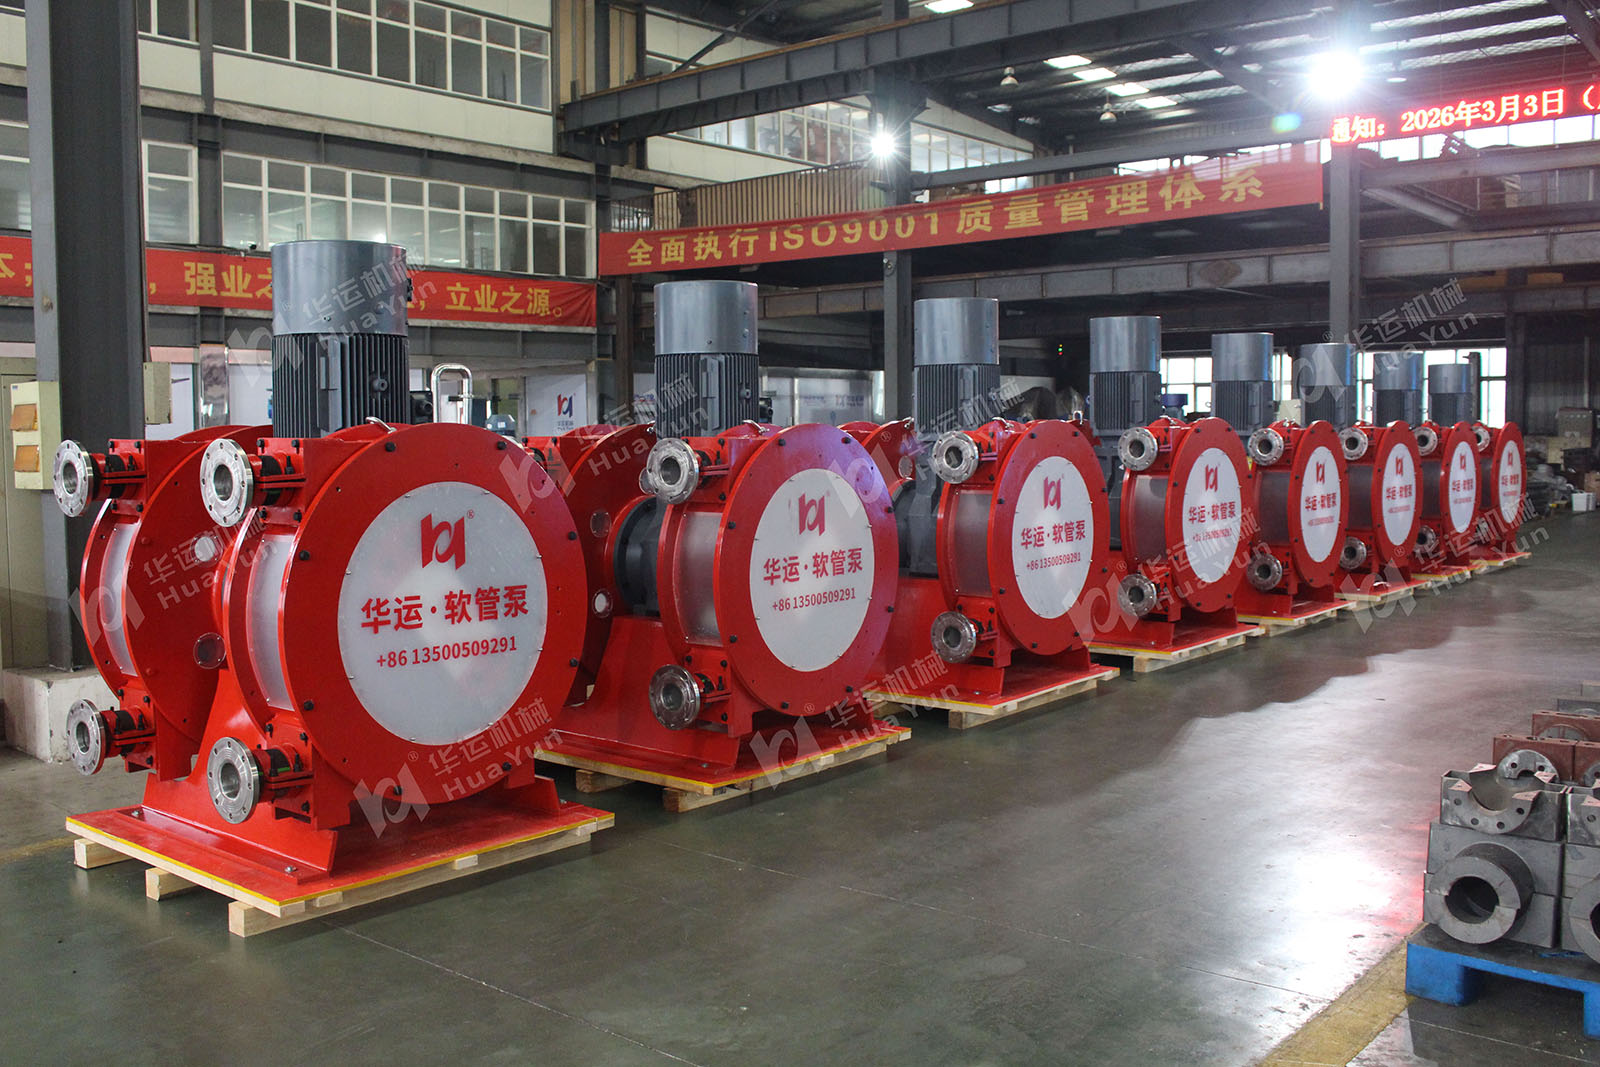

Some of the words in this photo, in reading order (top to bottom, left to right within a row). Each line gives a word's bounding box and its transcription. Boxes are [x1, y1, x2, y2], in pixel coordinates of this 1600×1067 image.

[361, 584, 529, 635] 华运·软管泵
[772, 598, 791, 612] +86
[793, 587, 856, 609] 13500509291
[377, 650, 407, 669] +86
[412, 636, 517, 665] 13500509291
